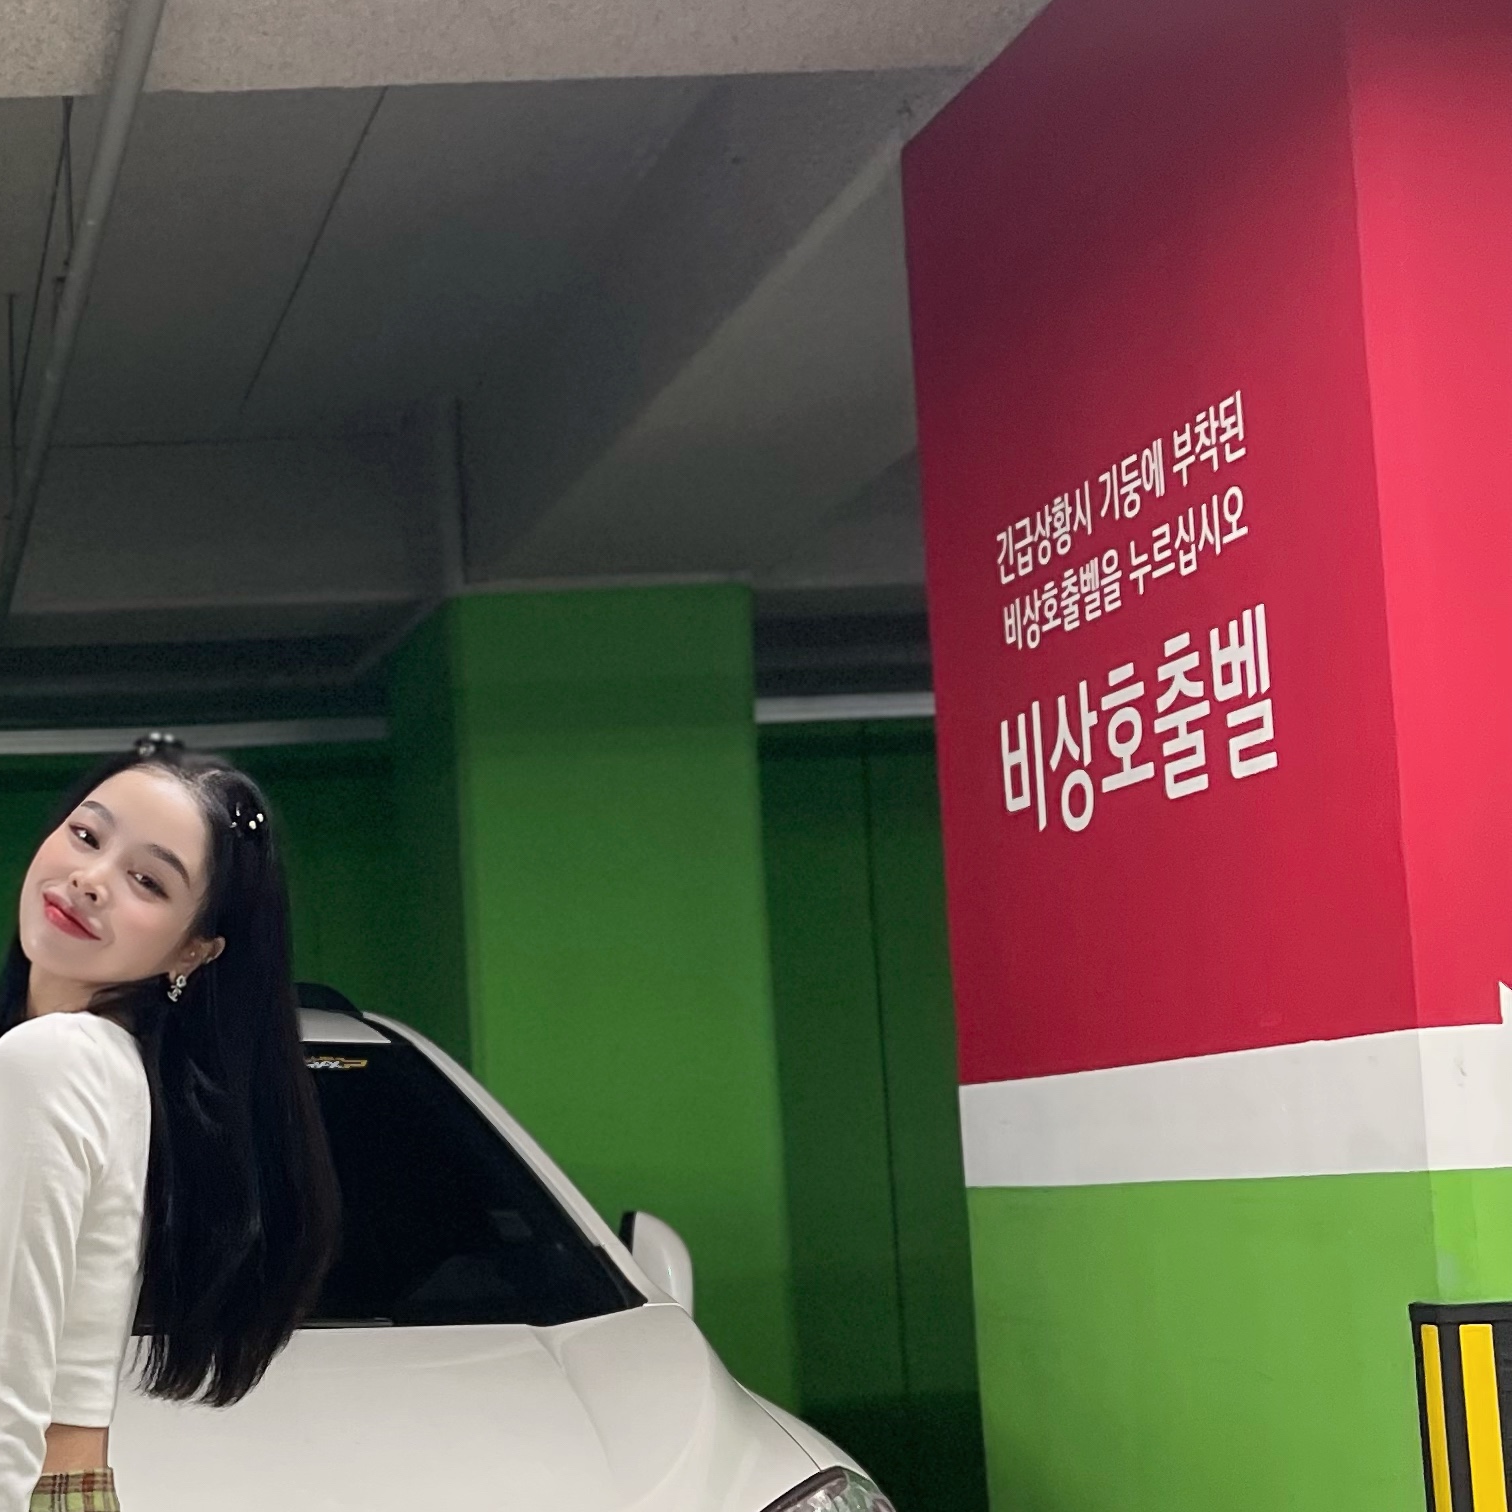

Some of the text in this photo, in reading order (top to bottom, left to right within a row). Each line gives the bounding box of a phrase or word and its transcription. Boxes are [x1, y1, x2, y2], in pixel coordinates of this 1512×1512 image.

[996, 390, 1246, 584] 긴급상황시 기둥에 부착된
[1003, 486, 1248, 650] 비상호출벨을 누르십시오
[1000, 603, 1278, 832] 비상호출벨
